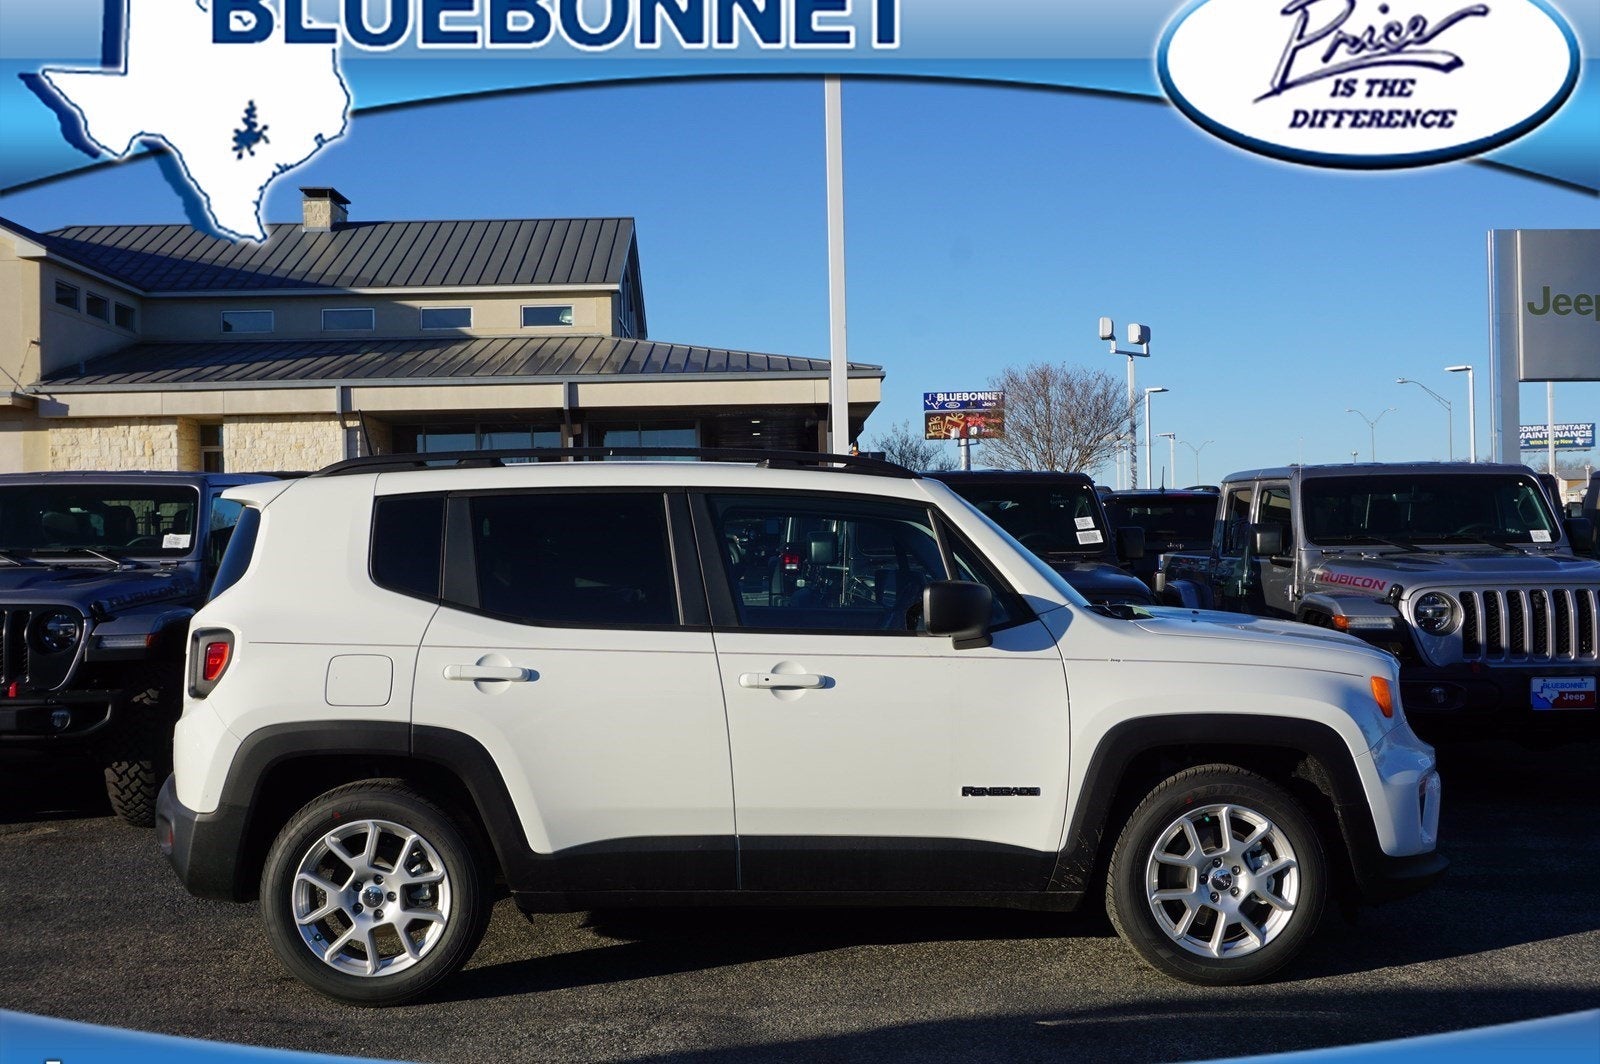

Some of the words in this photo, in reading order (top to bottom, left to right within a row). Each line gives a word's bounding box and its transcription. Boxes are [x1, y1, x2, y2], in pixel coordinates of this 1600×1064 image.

[1527, 286, 1600, 321] Jee
[937, 391, 1003, 401] BLUEBONNET
[1519, 430, 1592, 439] MAINTNANCE
[1320, 571, 1387, 591] RUBICON
[1563, 693, 1586, 702] Jeep
[962, 786, 1041, 796] RENEGADE
